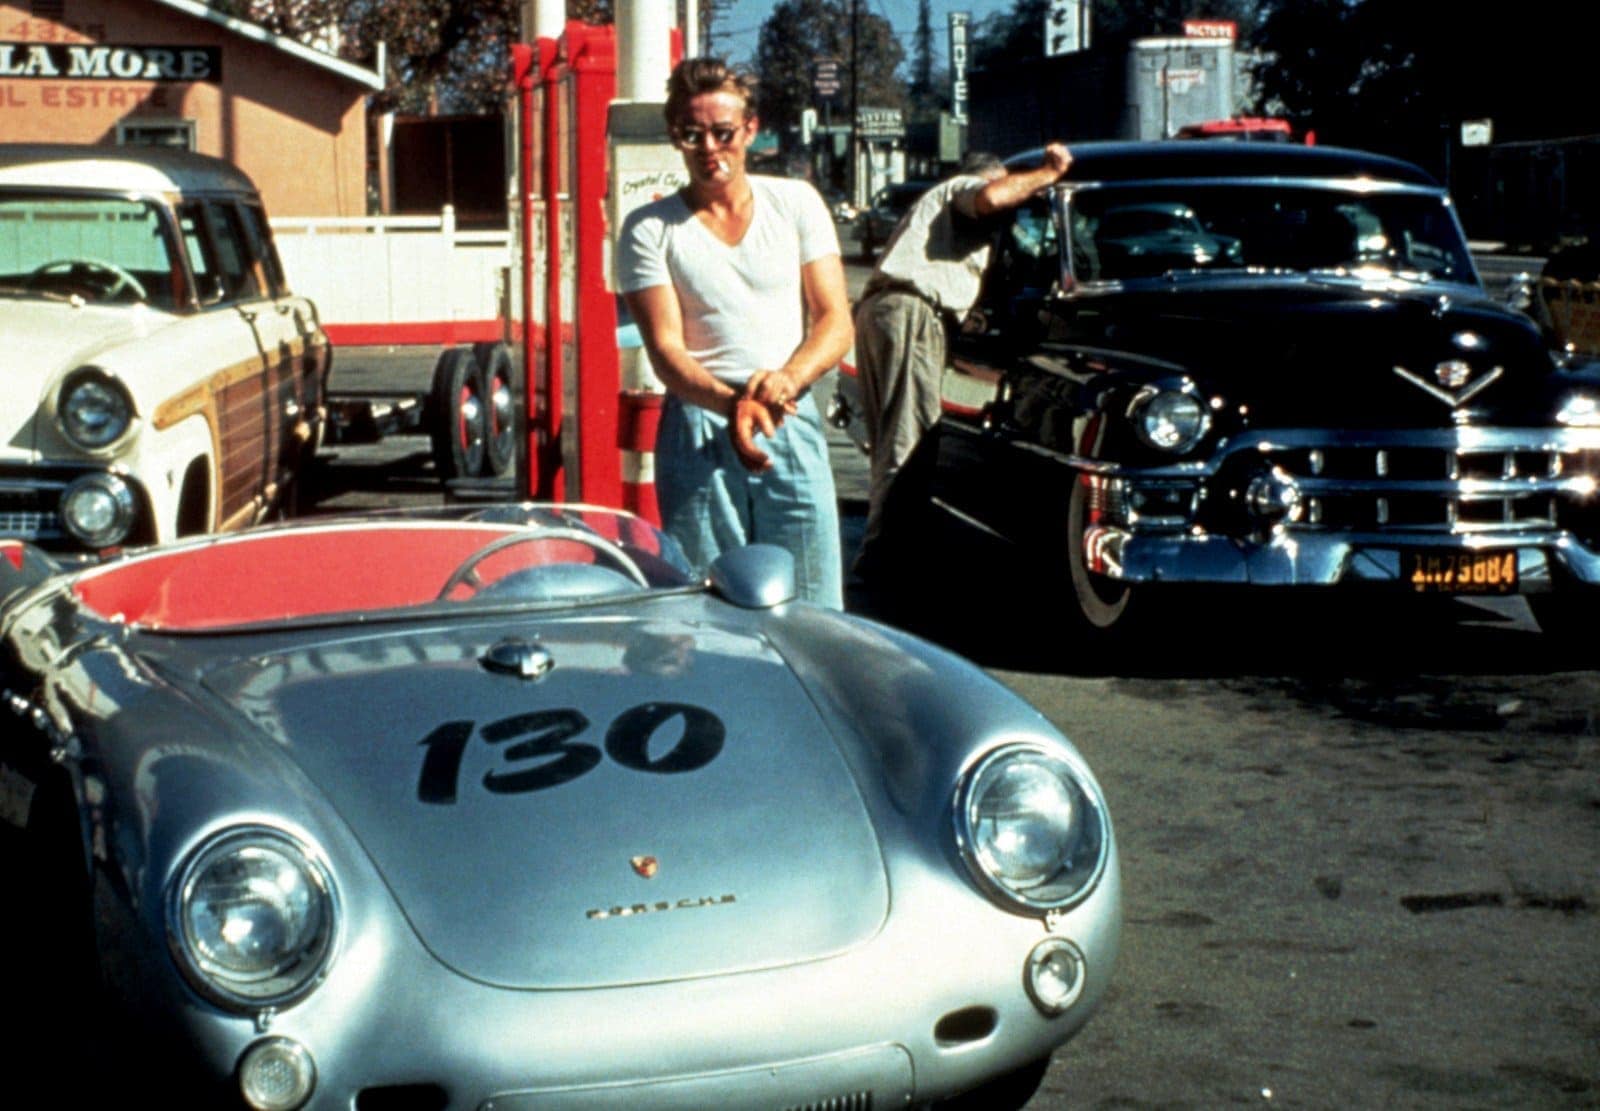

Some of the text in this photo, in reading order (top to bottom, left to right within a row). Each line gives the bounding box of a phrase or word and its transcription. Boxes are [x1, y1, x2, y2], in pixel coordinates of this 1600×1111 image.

[67, 46, 211, 79] MORE
[952, 26, 967, 122] MOTEL
[41, 87, 167, 108] ESTATE
[417, 701, 726, 805] 130
